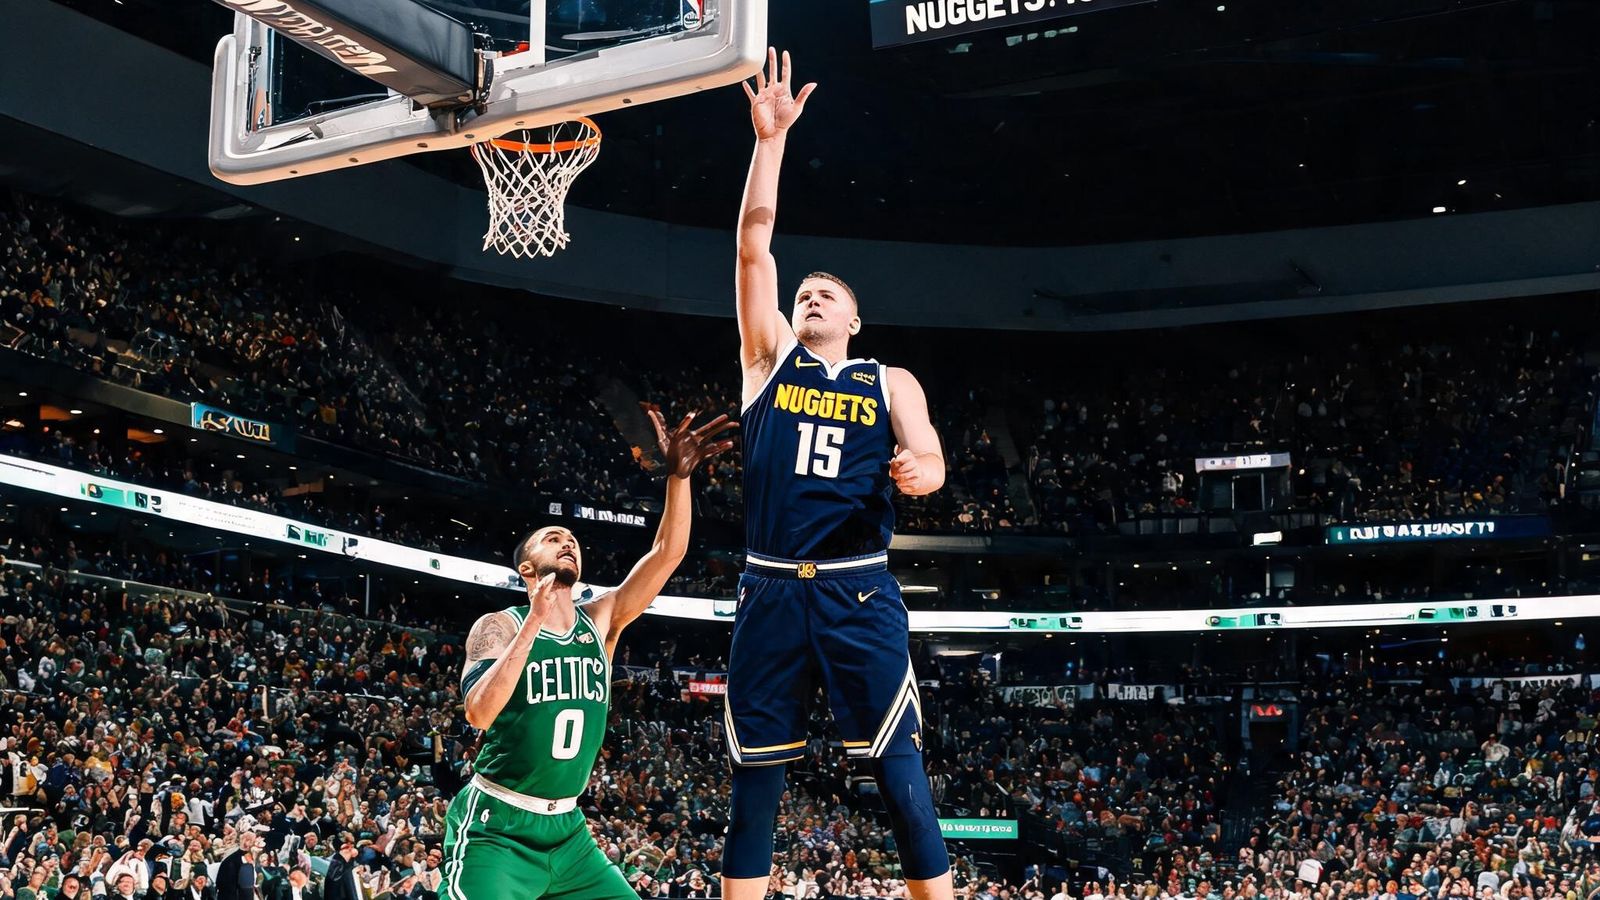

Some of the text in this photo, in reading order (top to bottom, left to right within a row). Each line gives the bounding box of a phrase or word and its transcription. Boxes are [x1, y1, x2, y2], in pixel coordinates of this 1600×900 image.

[773, 383, 878, 426] NUGGETS
[794, 422, 846, 478] 15
[526, 656, 606, 704] CELTICS
[551, 708, 585, 760] 0
